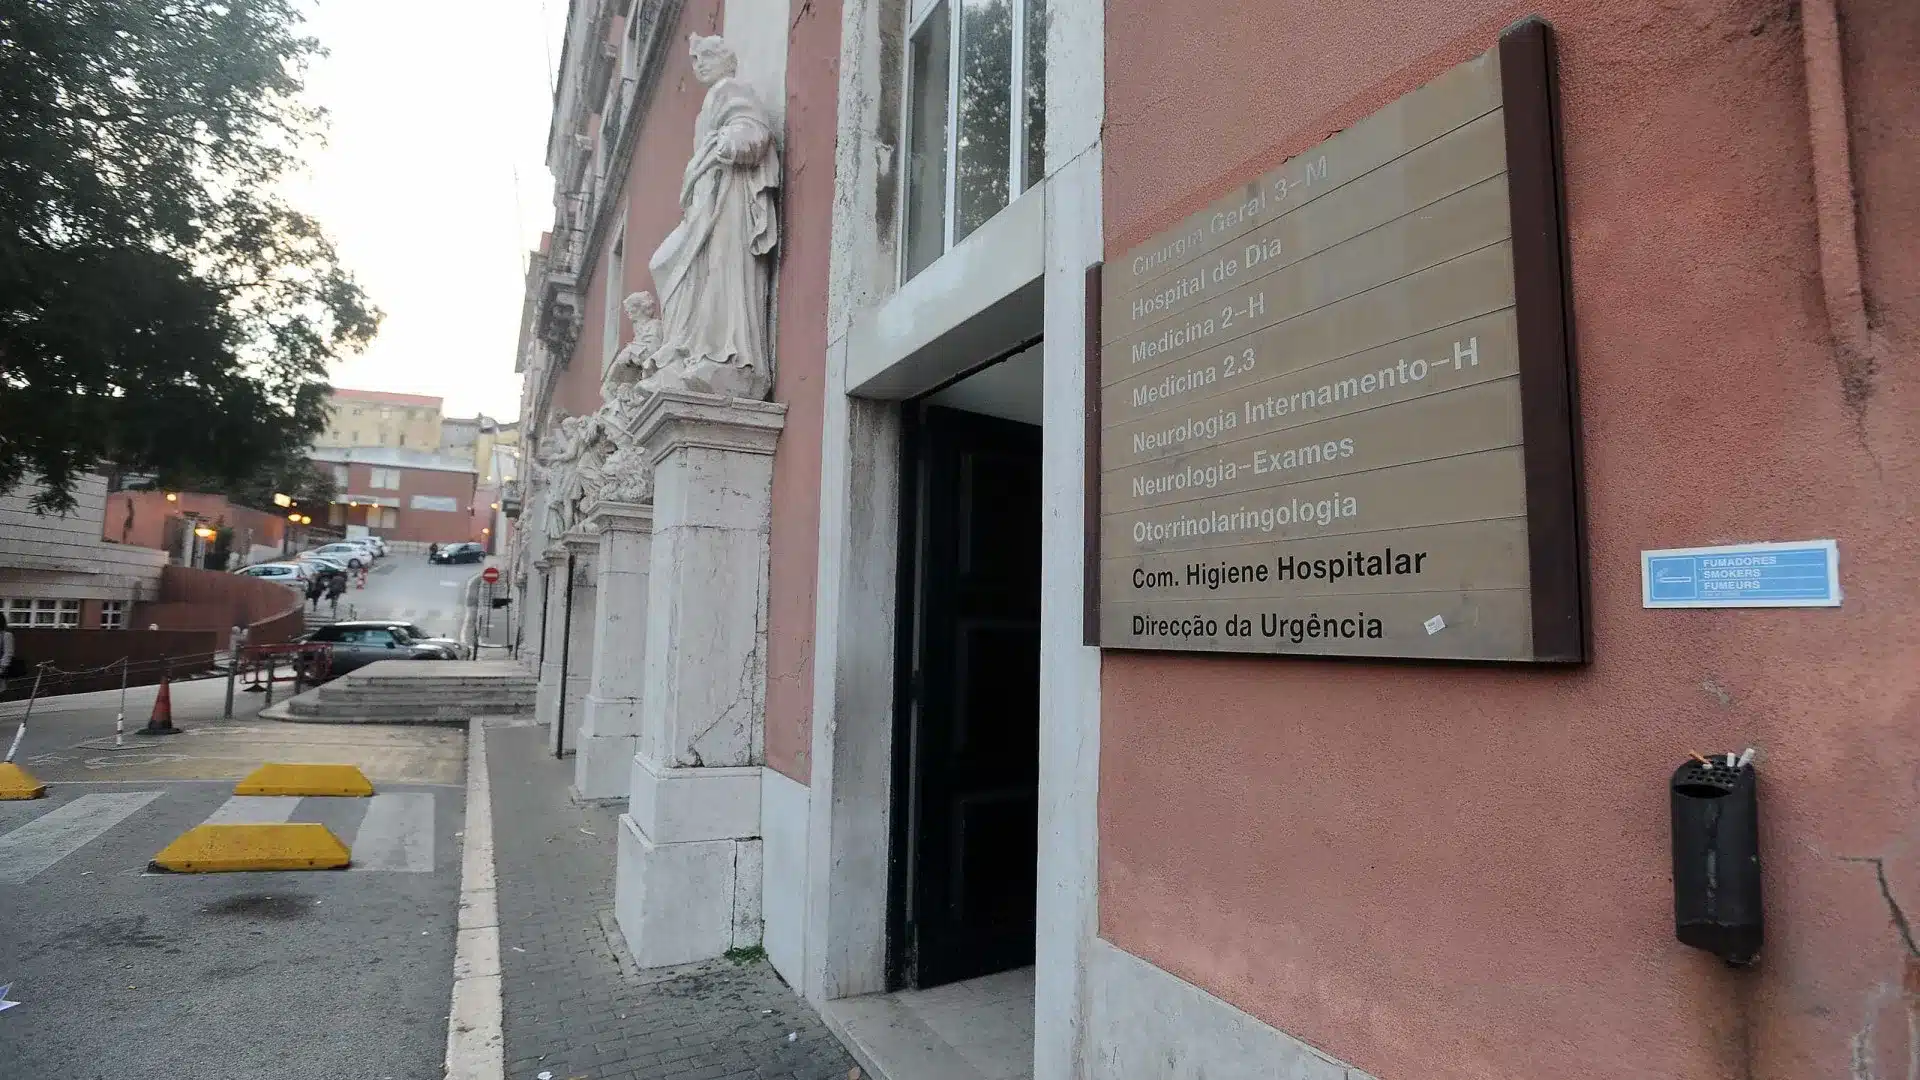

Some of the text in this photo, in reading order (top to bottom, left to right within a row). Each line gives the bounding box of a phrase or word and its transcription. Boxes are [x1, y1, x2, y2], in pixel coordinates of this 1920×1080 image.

[1132, 227, 1203, 276] Cirurgia
[1211, 187, 1267, 234] Geral
[1132, 236, 1282, 320] Hospital de Dia
[1132, 318, 1214, 364] Medicina
[1132, 348, 1256, 408] Medicina 2.3
[1132, 412, 1238, 453] Neurologia
[1133, 492, 1358, 543] Otorrinolaringologia
[1132, 547, 1427, 591] Com. Higiene Hospitalar
[1703, 556, 1777, 567] FUMADORES
[1703, 569, 1761, 579] SMOKERS
[1704, 580, 1761, 590] FUMEURS
[1132, 612, 1384, 643] Direcção da Urgência
